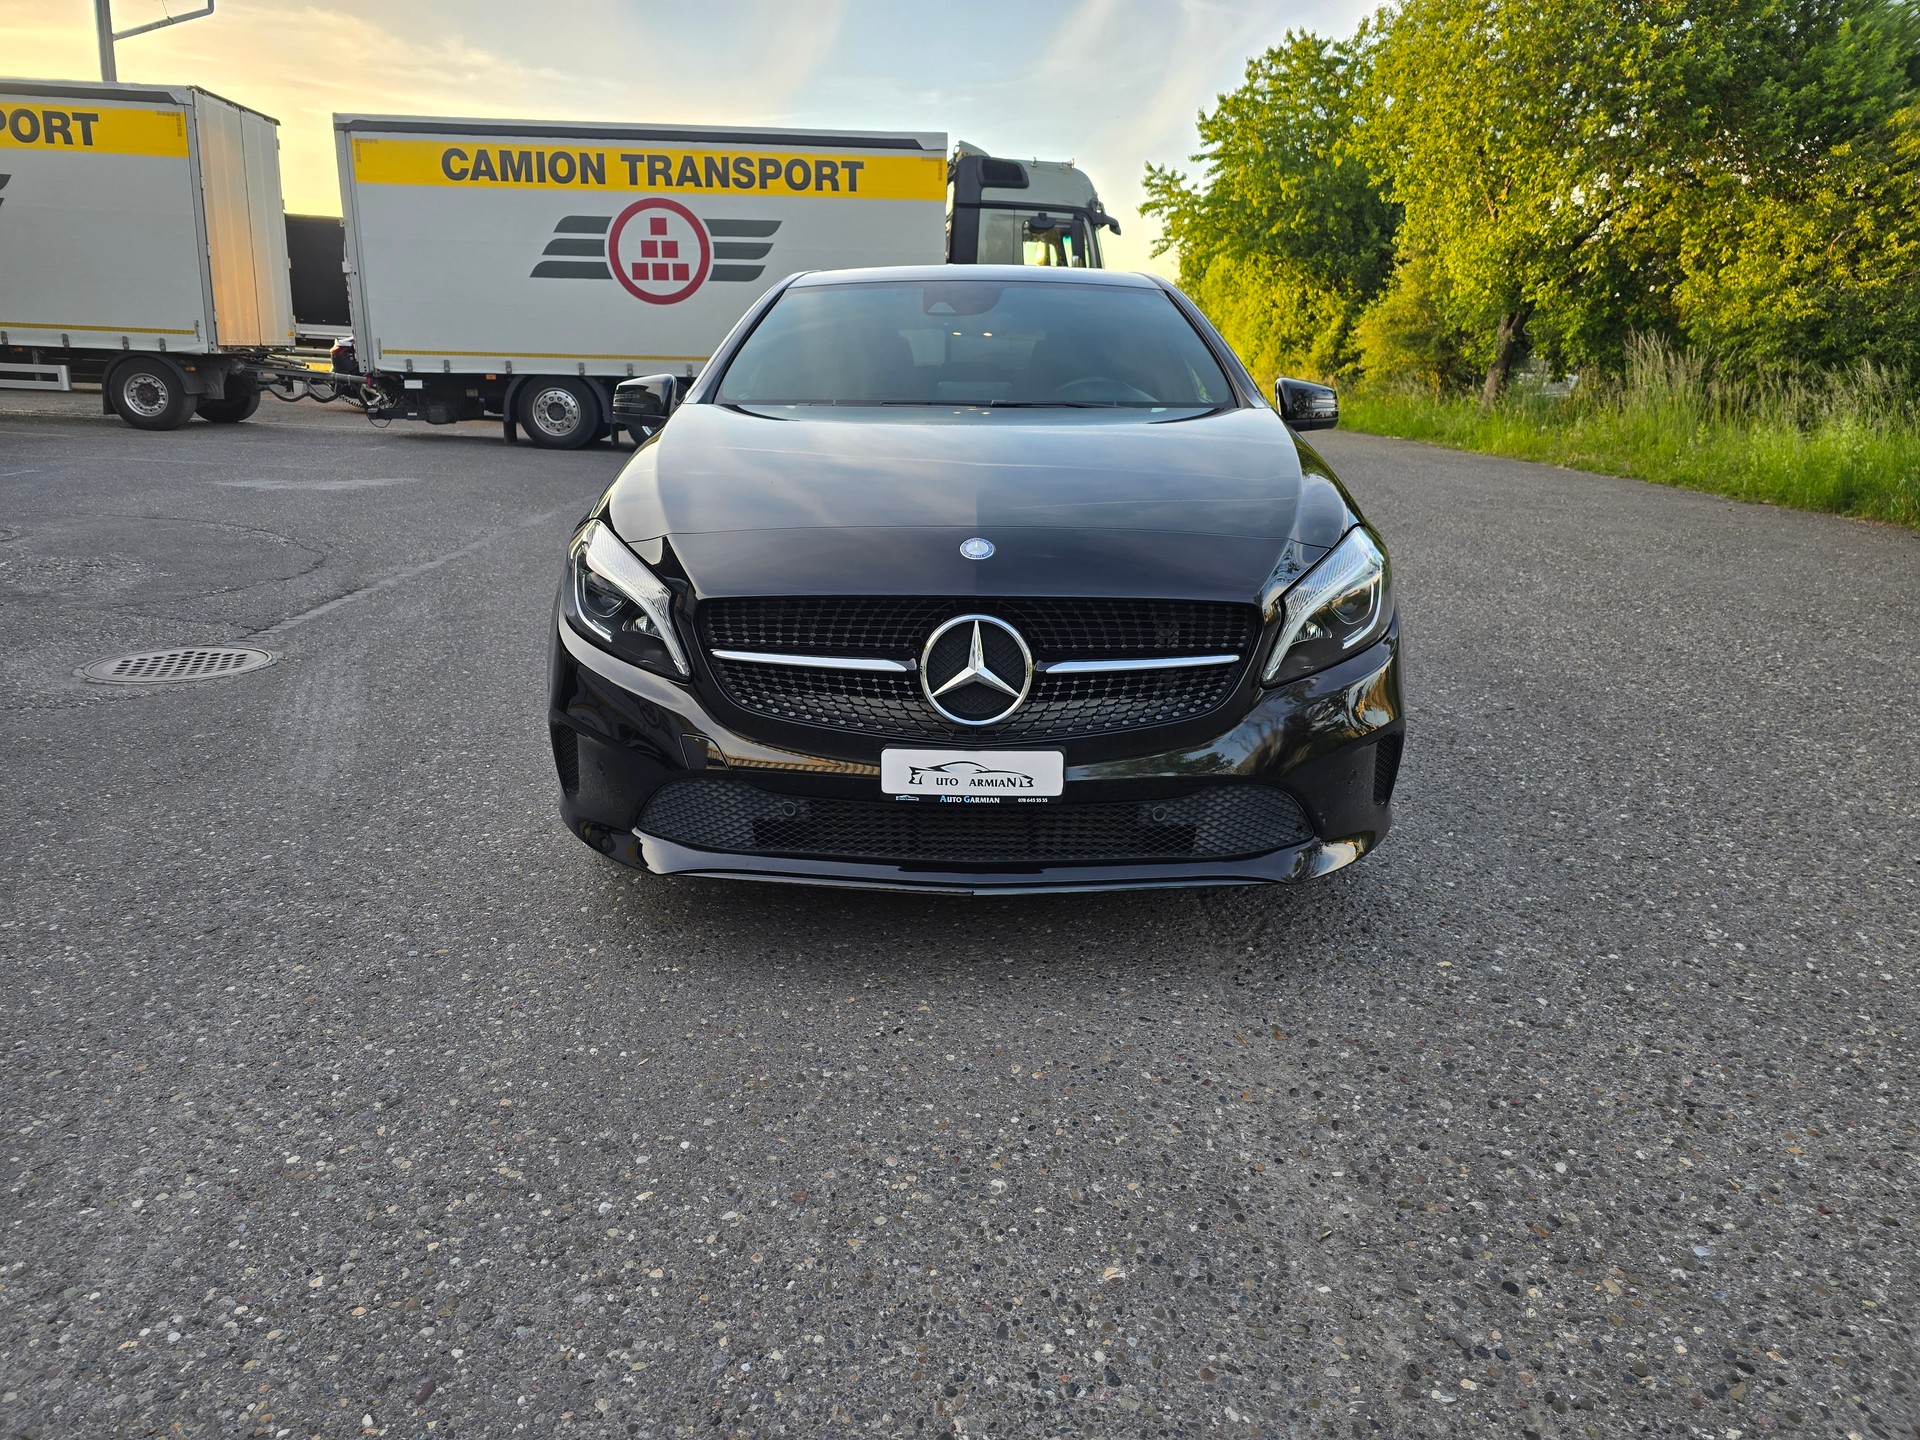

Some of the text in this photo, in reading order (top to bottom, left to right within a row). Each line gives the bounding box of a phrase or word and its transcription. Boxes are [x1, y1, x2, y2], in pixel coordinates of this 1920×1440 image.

[0, 108, 99, 146] ORT
[441, 148, 865, 193] CAMION TRANSPORT
[936, 777, 959, 786] UTO
[940, 795, 1000, 804] AUTO GARMIAN
